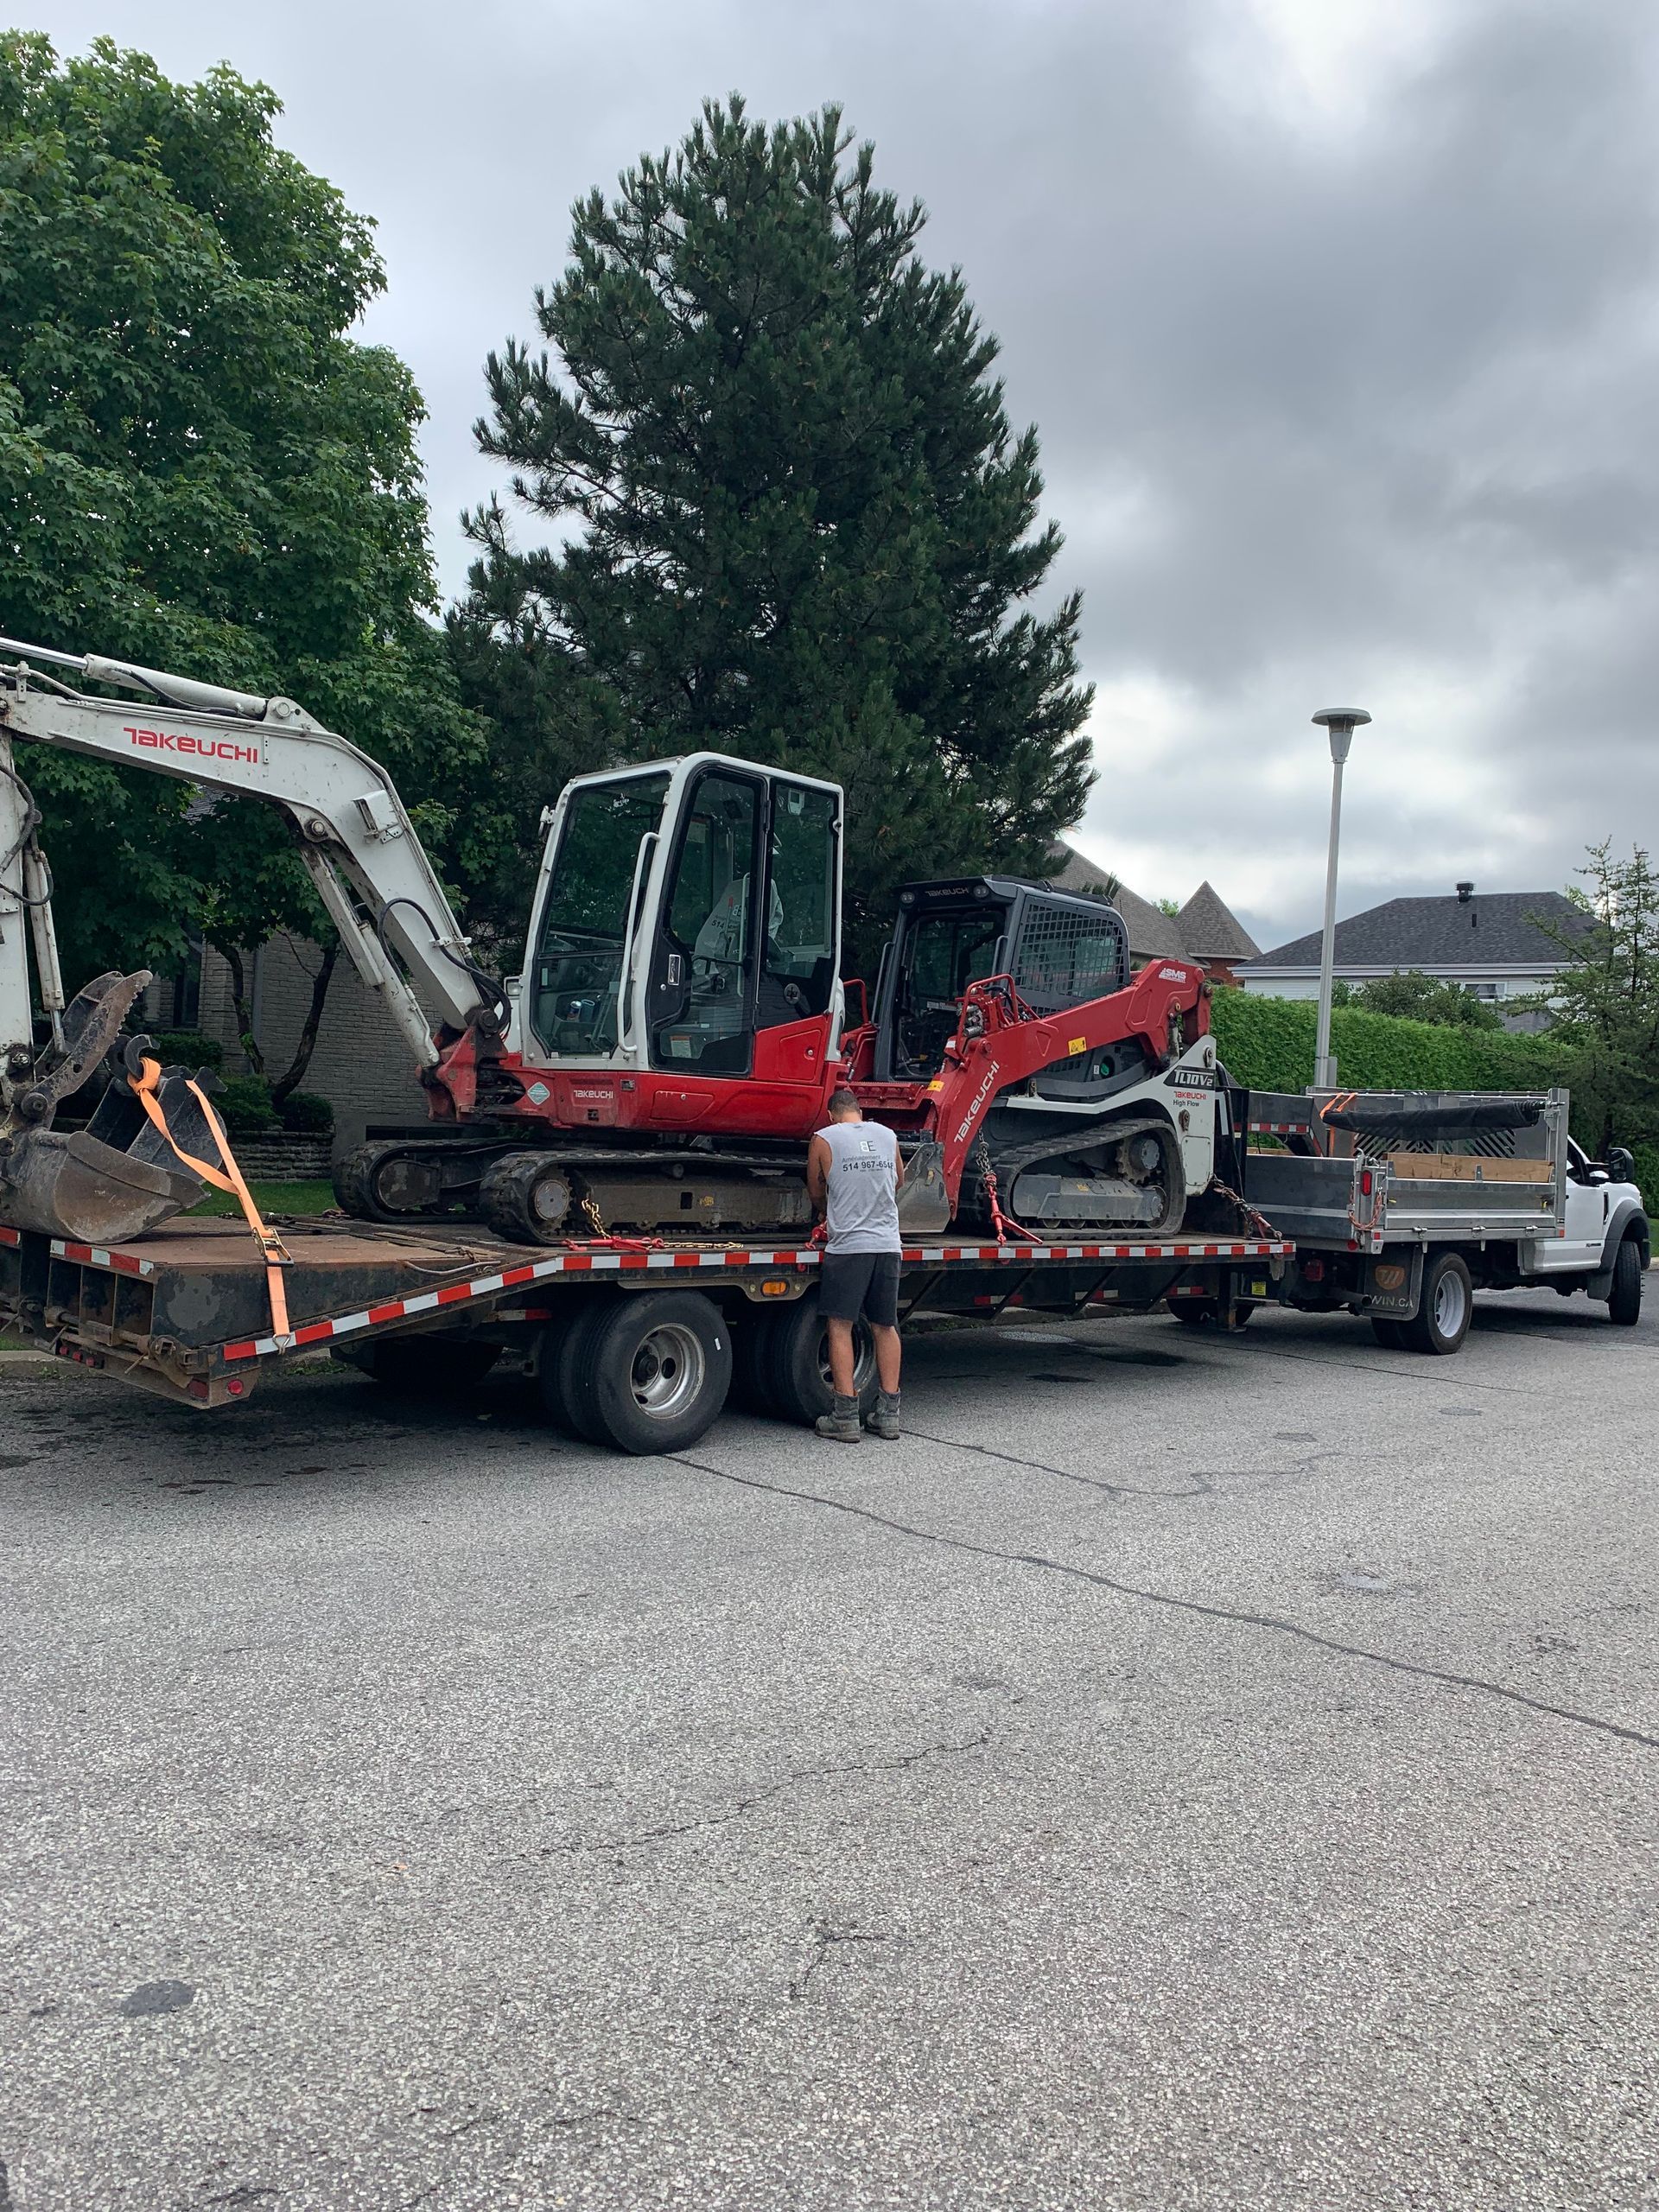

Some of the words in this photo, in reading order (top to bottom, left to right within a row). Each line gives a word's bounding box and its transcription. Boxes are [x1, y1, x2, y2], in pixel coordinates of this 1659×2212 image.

[124, 727, 257, 764] TAKEUCHI
[925, 887, 969, 897] TAKEUCH
[1166, 968, 1187, 980] SMS
[573, 1090, 613, 1099] TAKEUCHI
[1173, 1090, 1207, 1100] TAKEUCHI
[953, 1060, 1000, 1143] TAKEUCHI
[842, 1161, 859, 1172] 514
